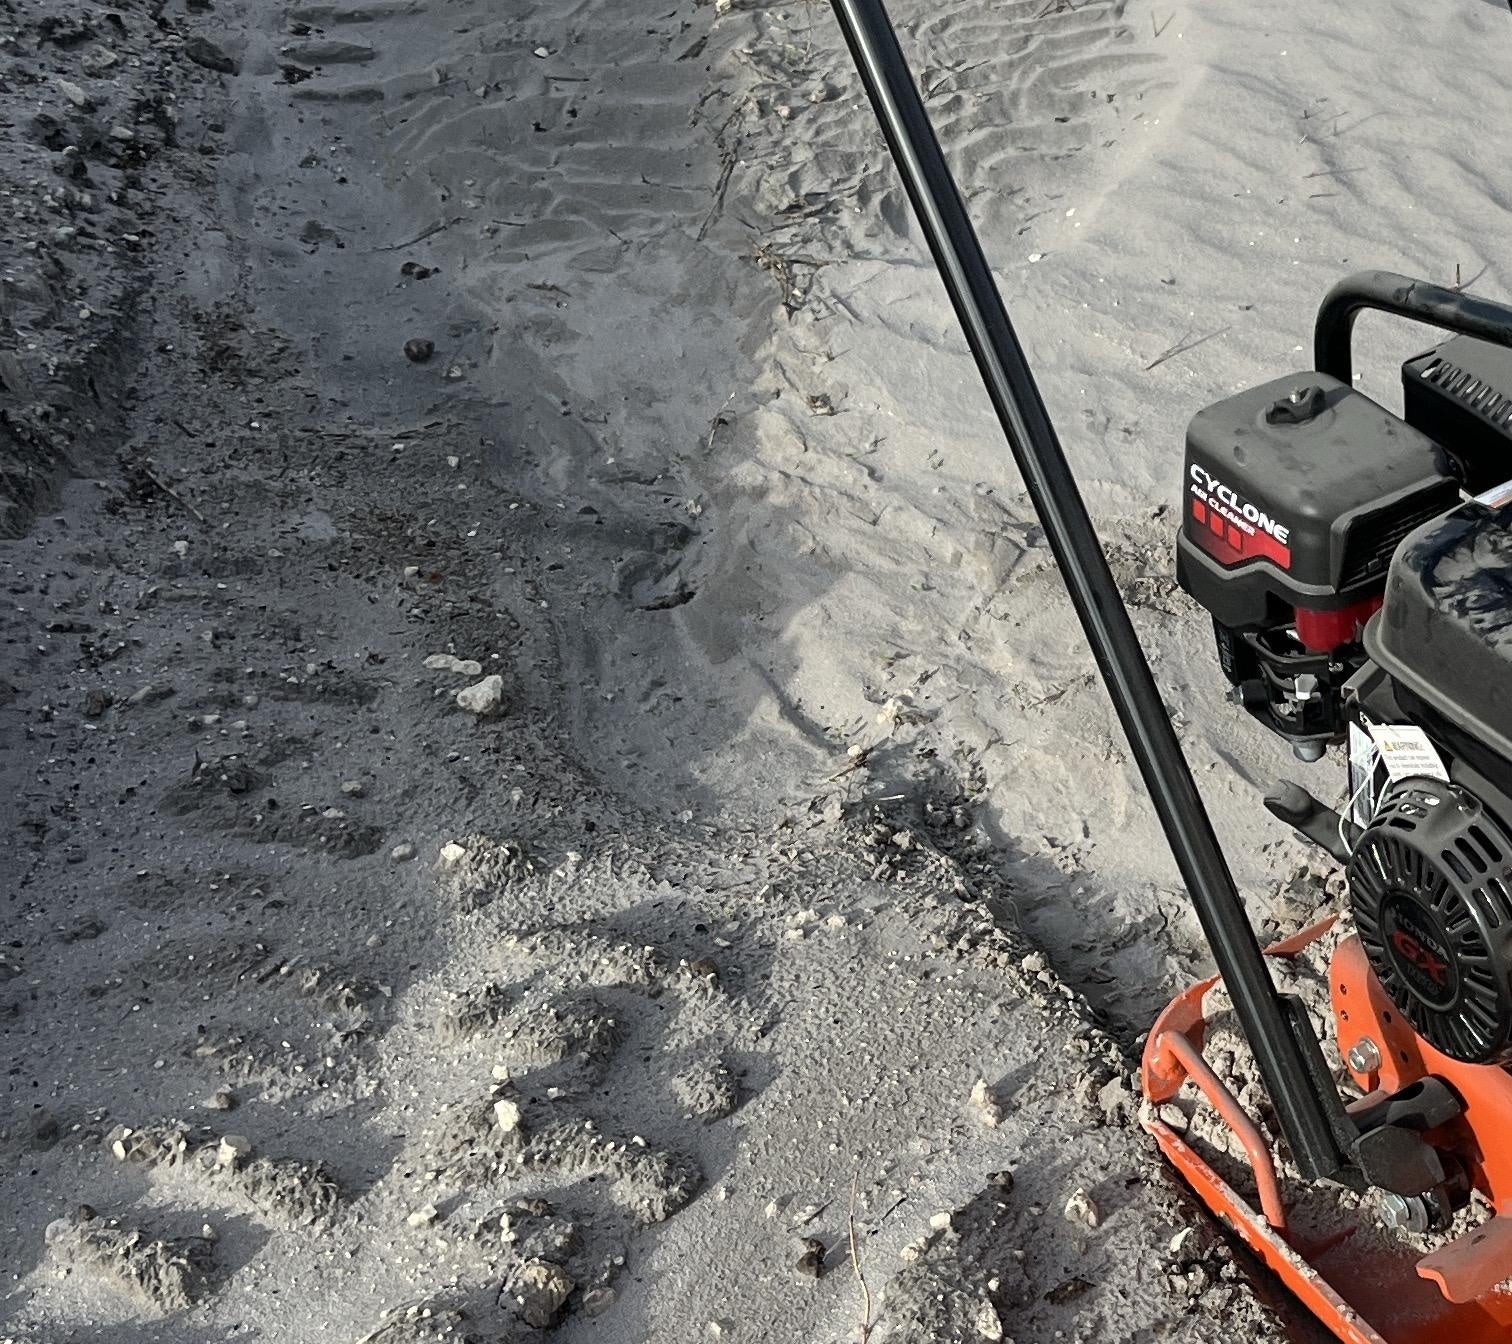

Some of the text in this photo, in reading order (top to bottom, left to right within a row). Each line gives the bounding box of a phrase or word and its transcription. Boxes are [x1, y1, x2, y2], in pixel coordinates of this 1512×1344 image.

[1190, 463, 1290, 545] CYCLONE
[1208, 497, 1256, 537] CLEANER
[1393, 928, 1448, 986] GX
